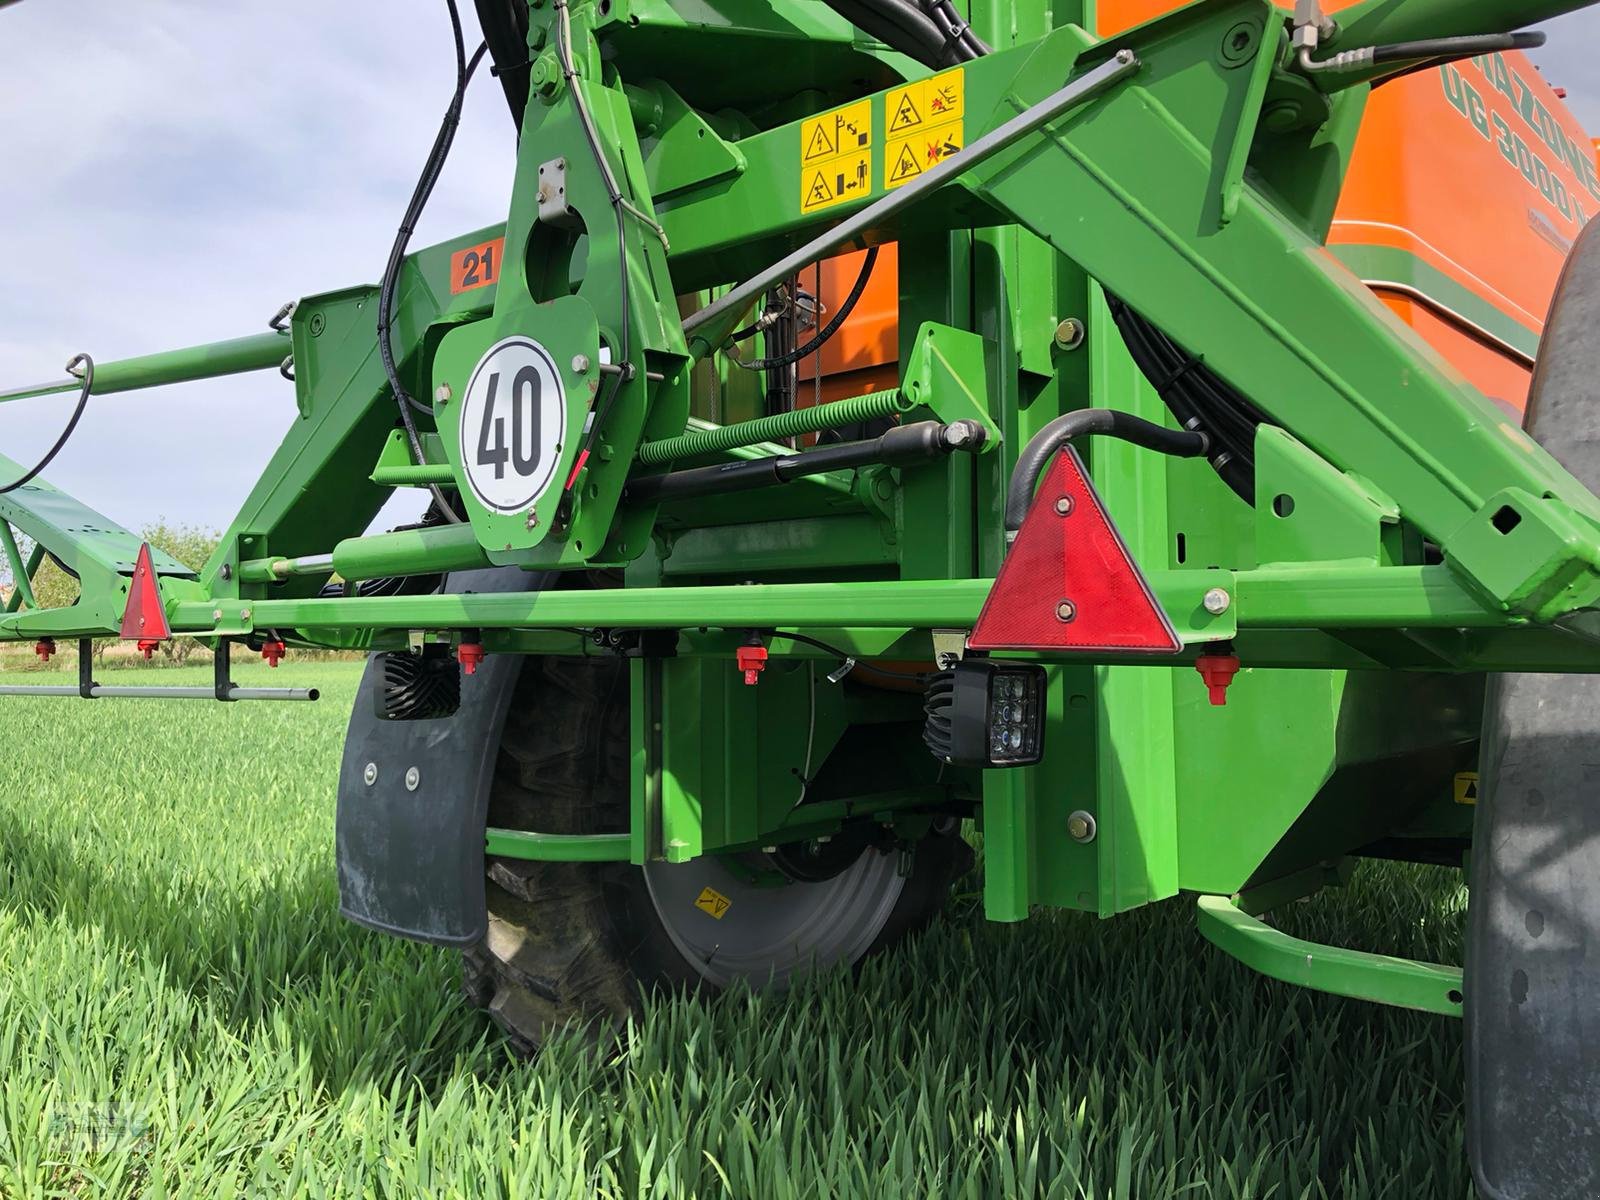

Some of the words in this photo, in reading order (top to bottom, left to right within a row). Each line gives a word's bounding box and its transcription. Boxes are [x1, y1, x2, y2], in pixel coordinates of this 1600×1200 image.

[1440, 64, 1492, 141] UG
[1491, 109, 1573, 223] 3000
[462, 246, 493, 287] 21
[477, 364, 542, 480] 40
